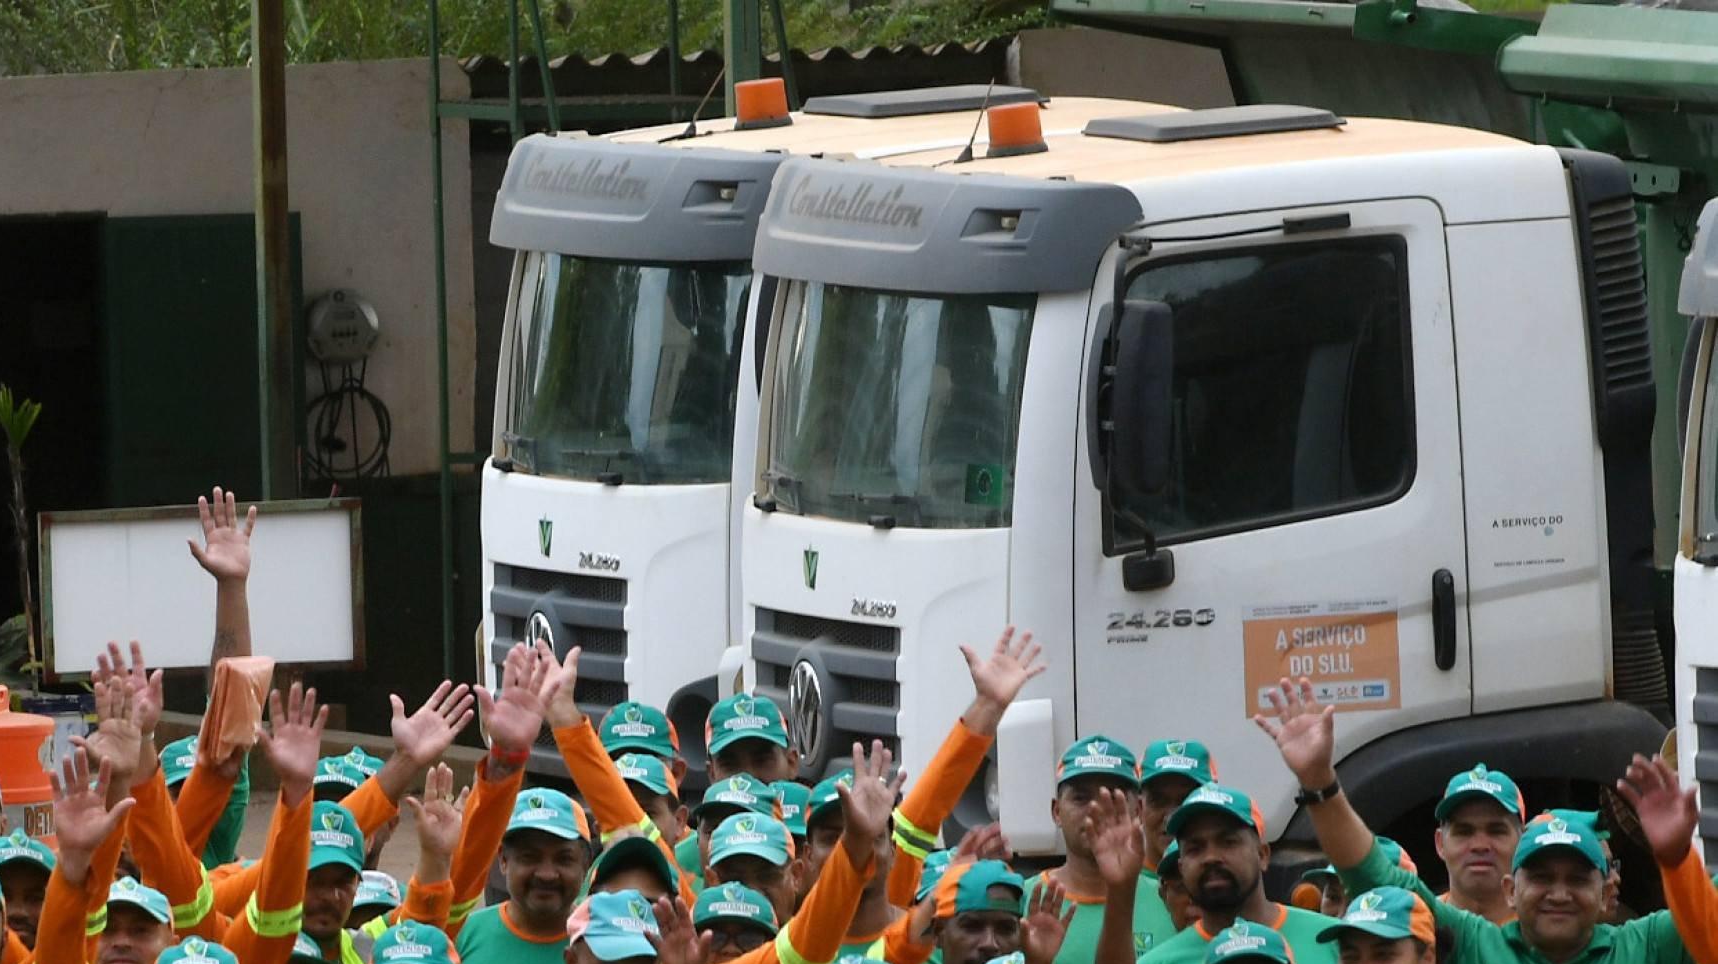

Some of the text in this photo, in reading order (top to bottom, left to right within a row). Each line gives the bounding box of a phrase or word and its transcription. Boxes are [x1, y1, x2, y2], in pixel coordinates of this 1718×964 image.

[525, 152, 649, 200] Constellation
[789, 174, 923, 228] Constellation
[1492, 519, 1499, 528] A
[1548, 514, 1563, 525] DO
[1274, 623, 1367, 650] A SERVIÇO
[1289, 652, 1355, 676] DO SLU.
